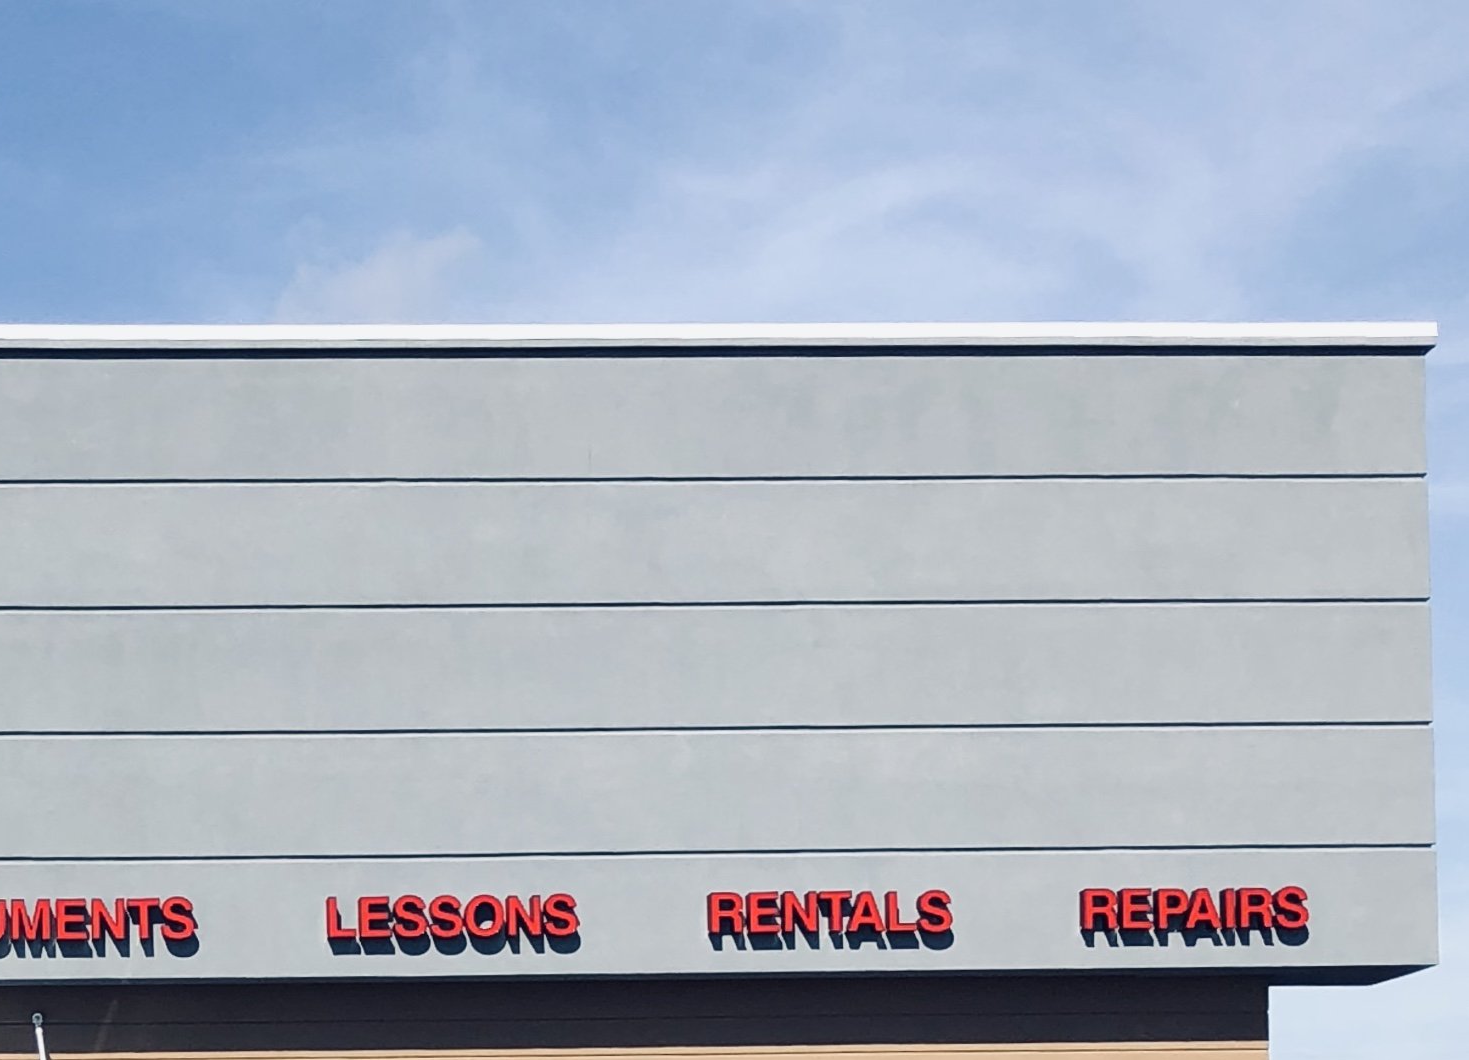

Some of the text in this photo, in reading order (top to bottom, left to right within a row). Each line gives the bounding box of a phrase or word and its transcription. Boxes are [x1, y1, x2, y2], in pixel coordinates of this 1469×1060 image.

[325, 893, 580, 938] LESSONS
[706, 888, 954, 934] RENTALS
[1079, 885, 1310, 931] REPAIRS
